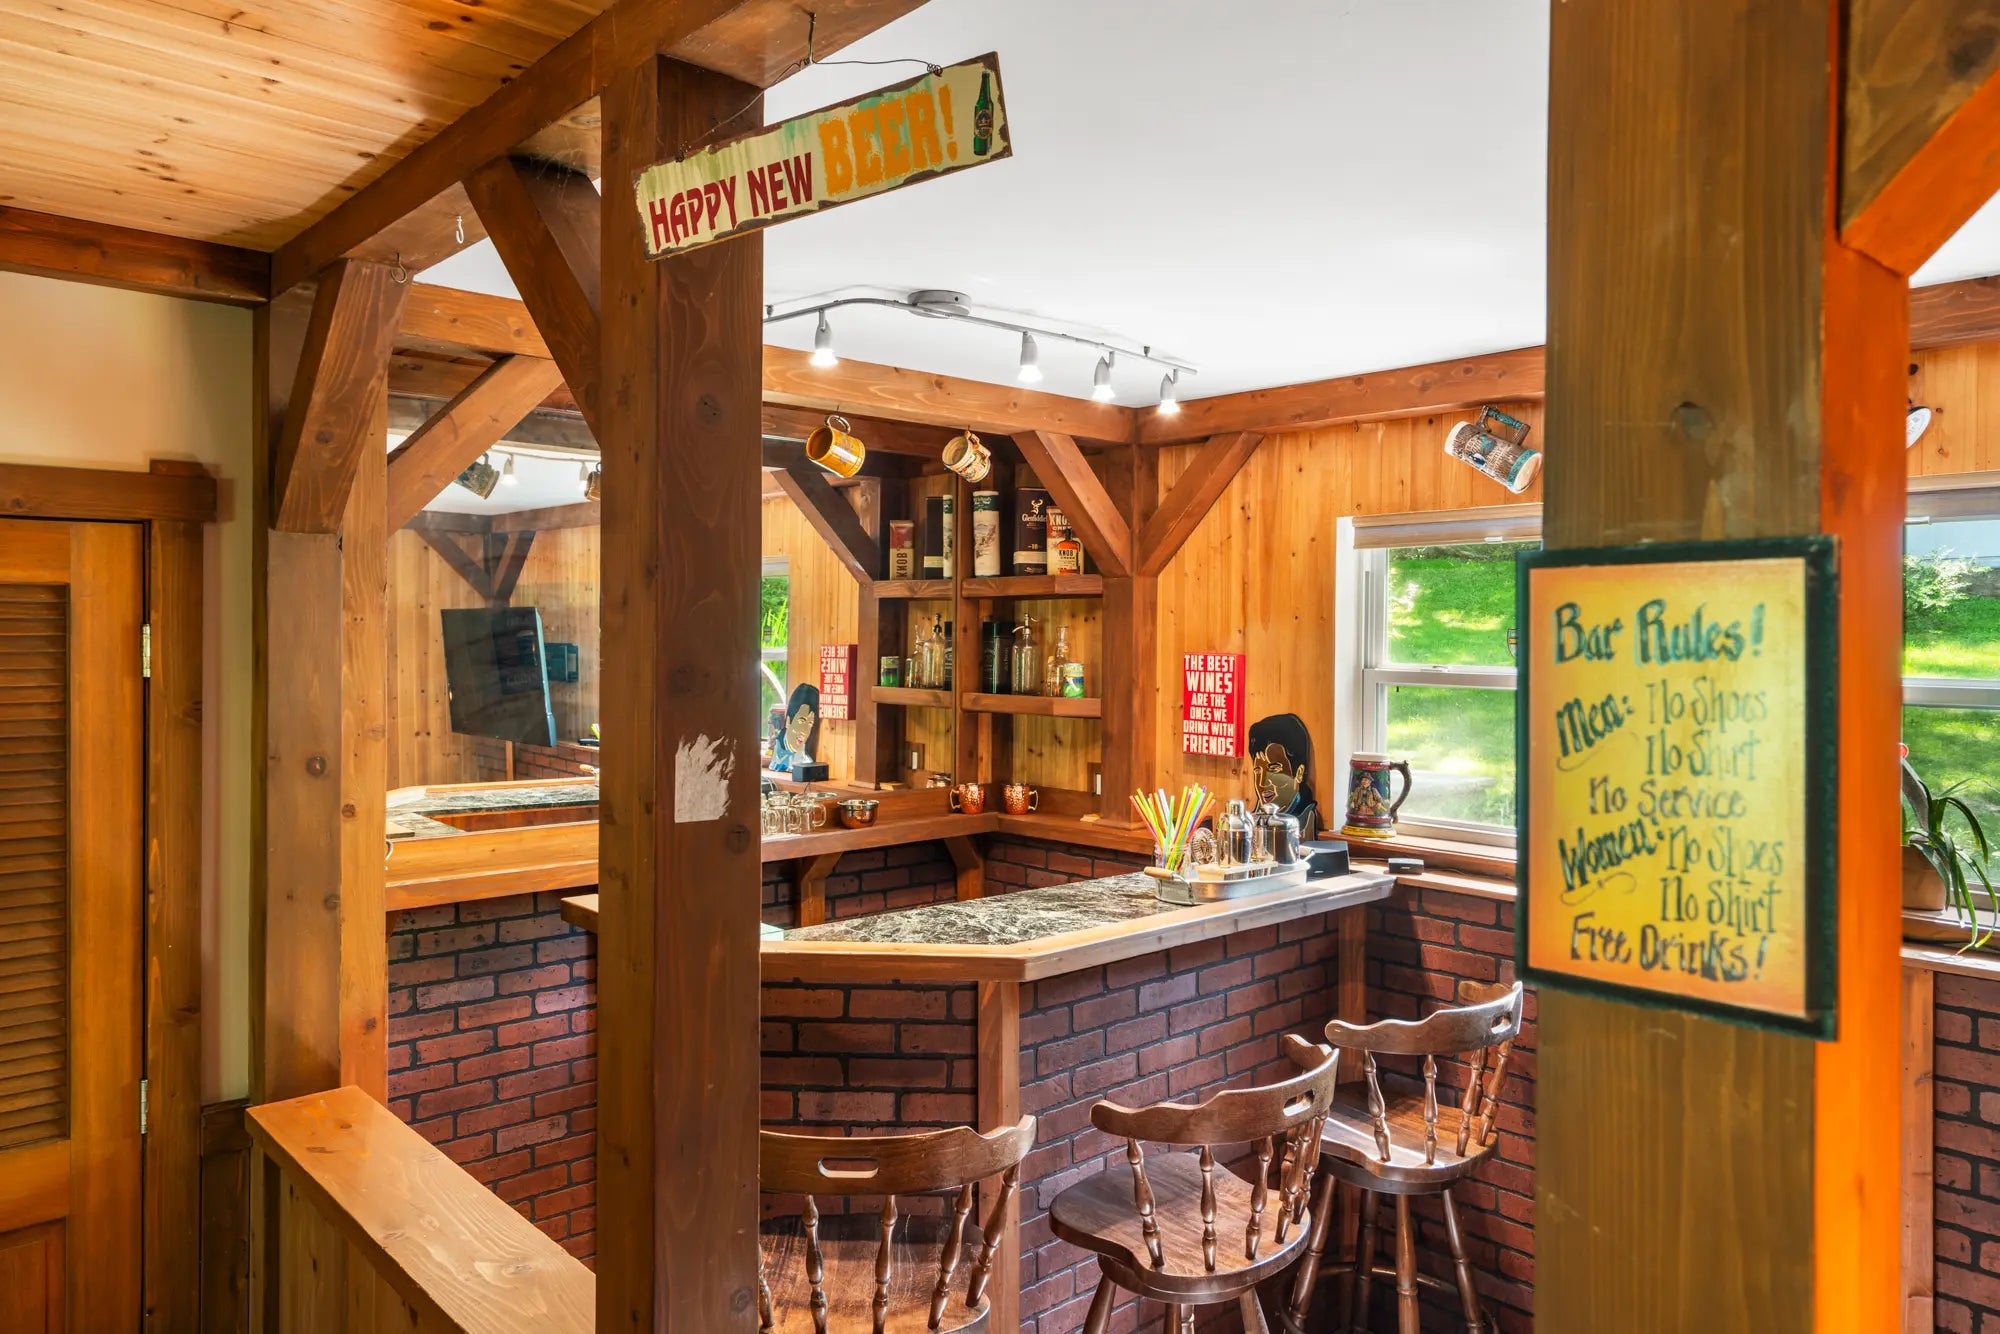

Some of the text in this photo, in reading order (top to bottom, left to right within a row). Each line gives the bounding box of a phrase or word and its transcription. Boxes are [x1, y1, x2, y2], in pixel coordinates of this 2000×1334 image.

[648, 83, 958, 252] HAPPY NEW BEER!
[1022, 513, 1047, 523] Glenfiddic
[1050, 514, 1070, 526] KNO
[1553, 598, 1765, 665] Bar Rules!
[1184, 655, 1235, 672] THE BEST
[1186, 671, 1233, 694] WINES
[1190, 707, 1227, 722] ONES WE
[1191, 693, 1226, 707] ARE THE
[1183, 720, 1234, 736] DRINK WITH
[1556, 694, 1634, 758] Men:
[1691, 676, 1767, 733] Shoes
[1183, 734, 1234, 757] FRIENDS
[1689, 729, 1760, 781] Shirt
[1638, 778, 1747, 818] Service
[1558, 817, 1664, 893] Women:
[1708, 825, 1784, 885] Shoes
[1707, 879, 1782, 938] Shirt
[1570, 911, 1769, 984] Free Drinks!
